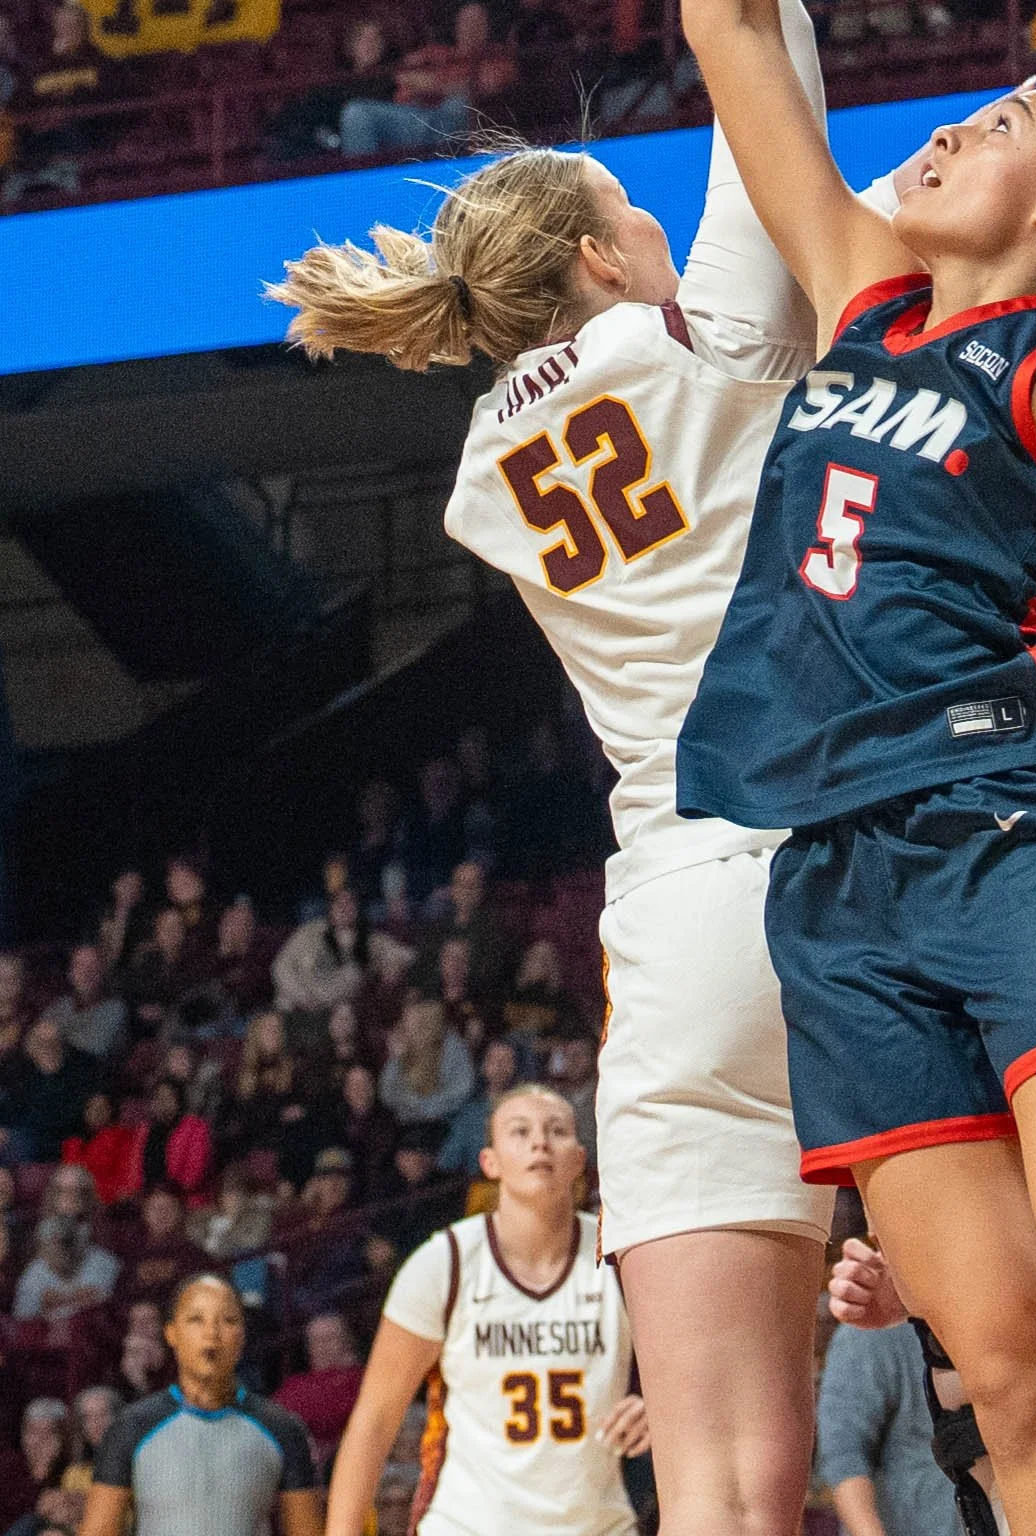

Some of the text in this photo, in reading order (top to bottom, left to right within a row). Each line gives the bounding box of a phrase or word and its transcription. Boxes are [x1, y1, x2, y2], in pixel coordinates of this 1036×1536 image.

[959, 340, 1010, 381] SOCON
[496, 428, 695, 598] 52
[798, 461, 880, 601] 5
[1001, 707, 1013, 721] L
[474, 1319, 606, 1359] MINNESOTA
[501, 1366, 587, 1446] 35
